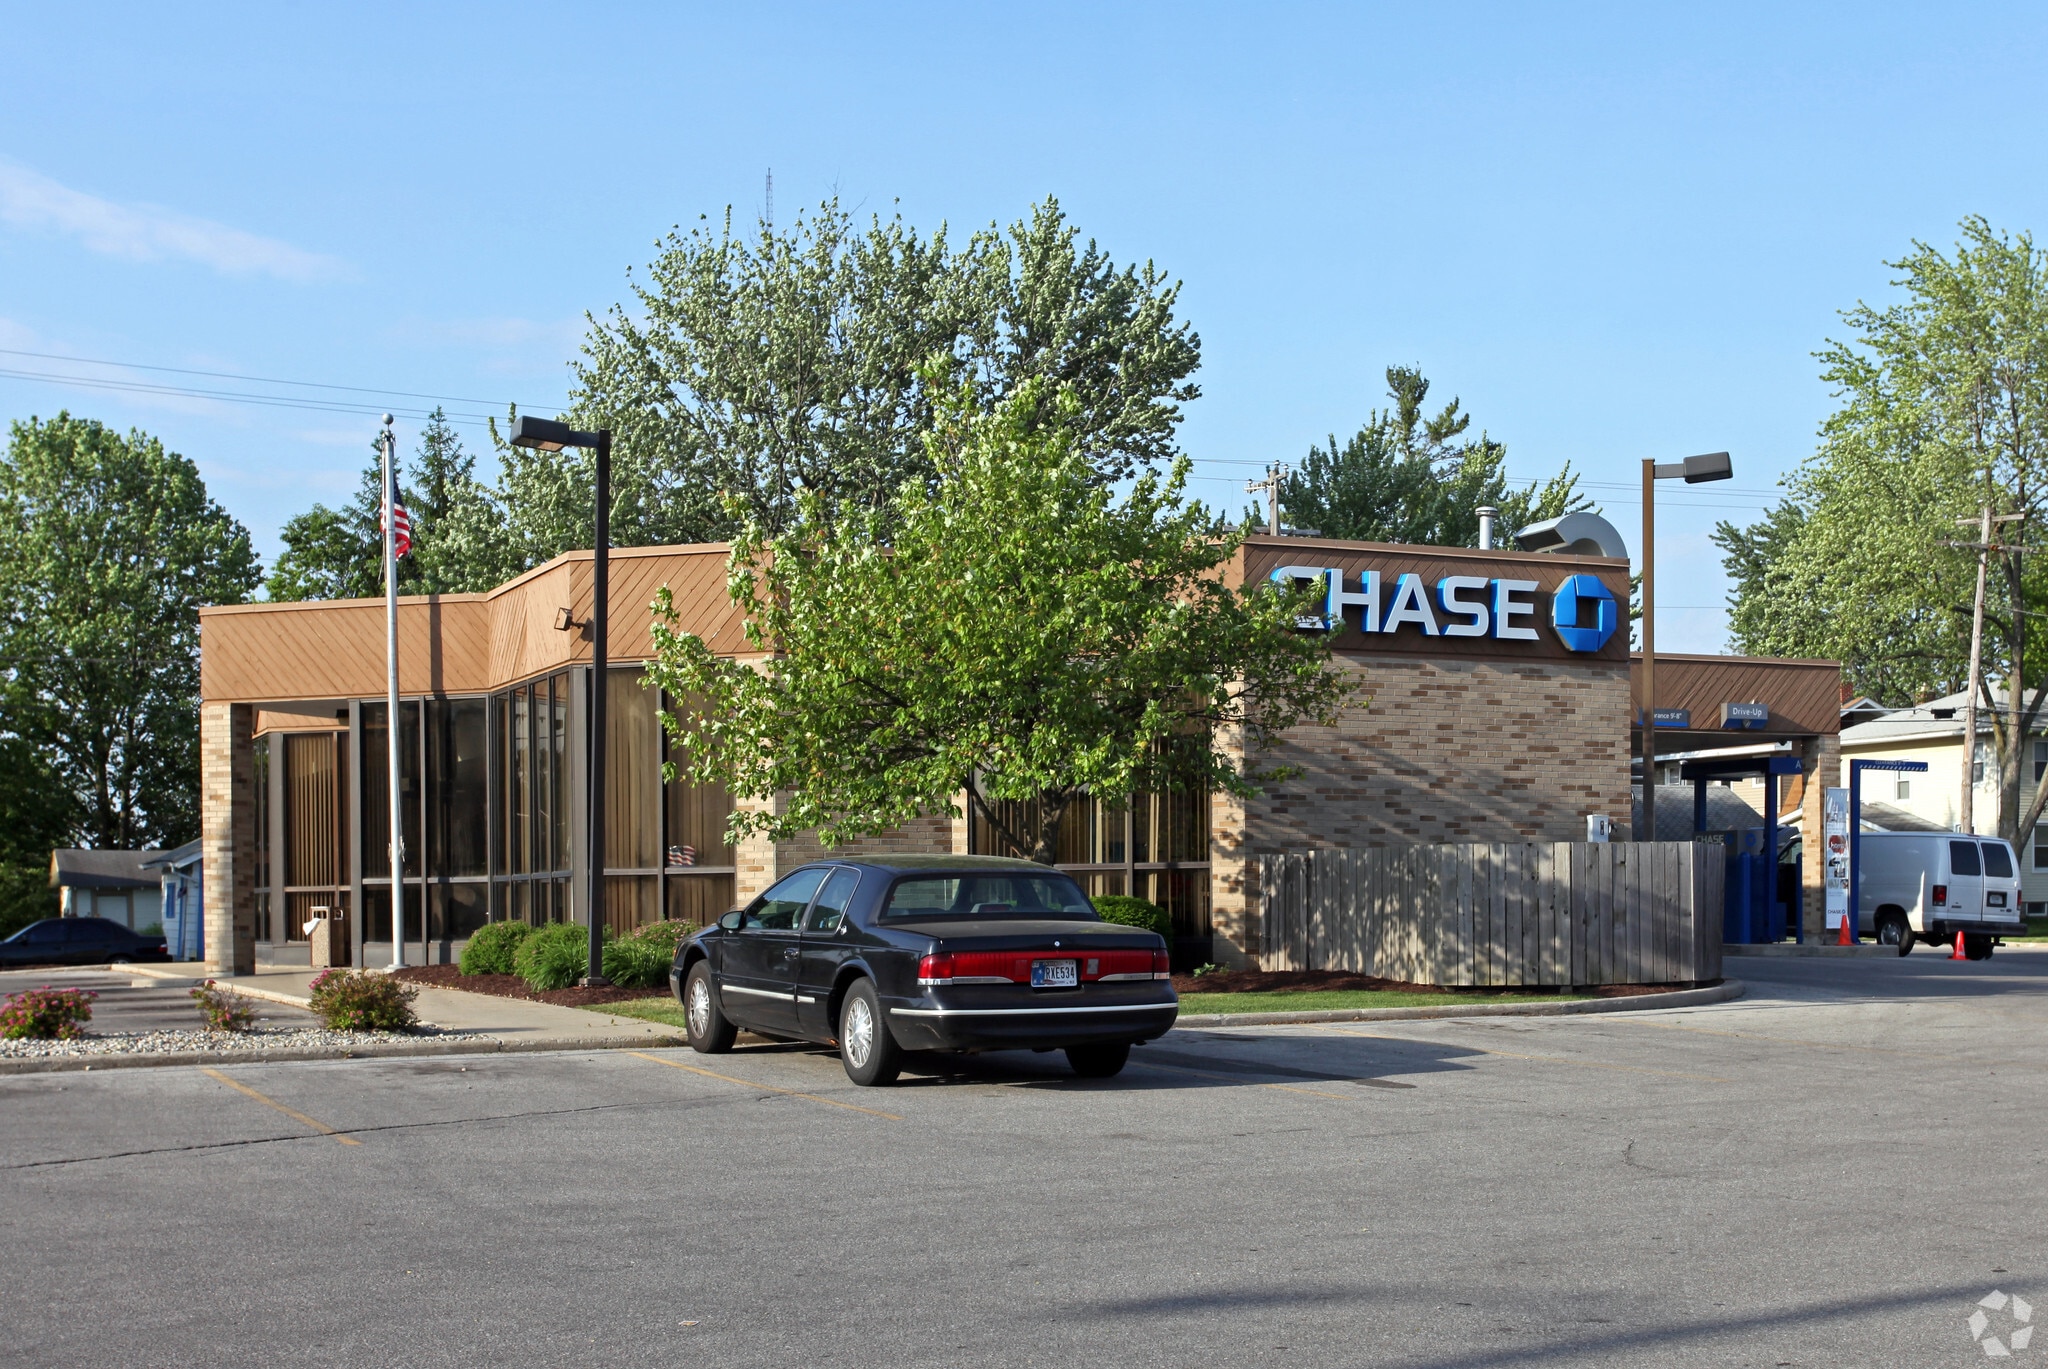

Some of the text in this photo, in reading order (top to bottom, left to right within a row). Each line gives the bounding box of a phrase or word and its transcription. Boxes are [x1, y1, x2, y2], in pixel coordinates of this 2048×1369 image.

[1732, 707, 1762, 717] Drive-Up
[1695, 834, 1725, 844] CHASE
[1045, 966, 1075, 979] RXE534
